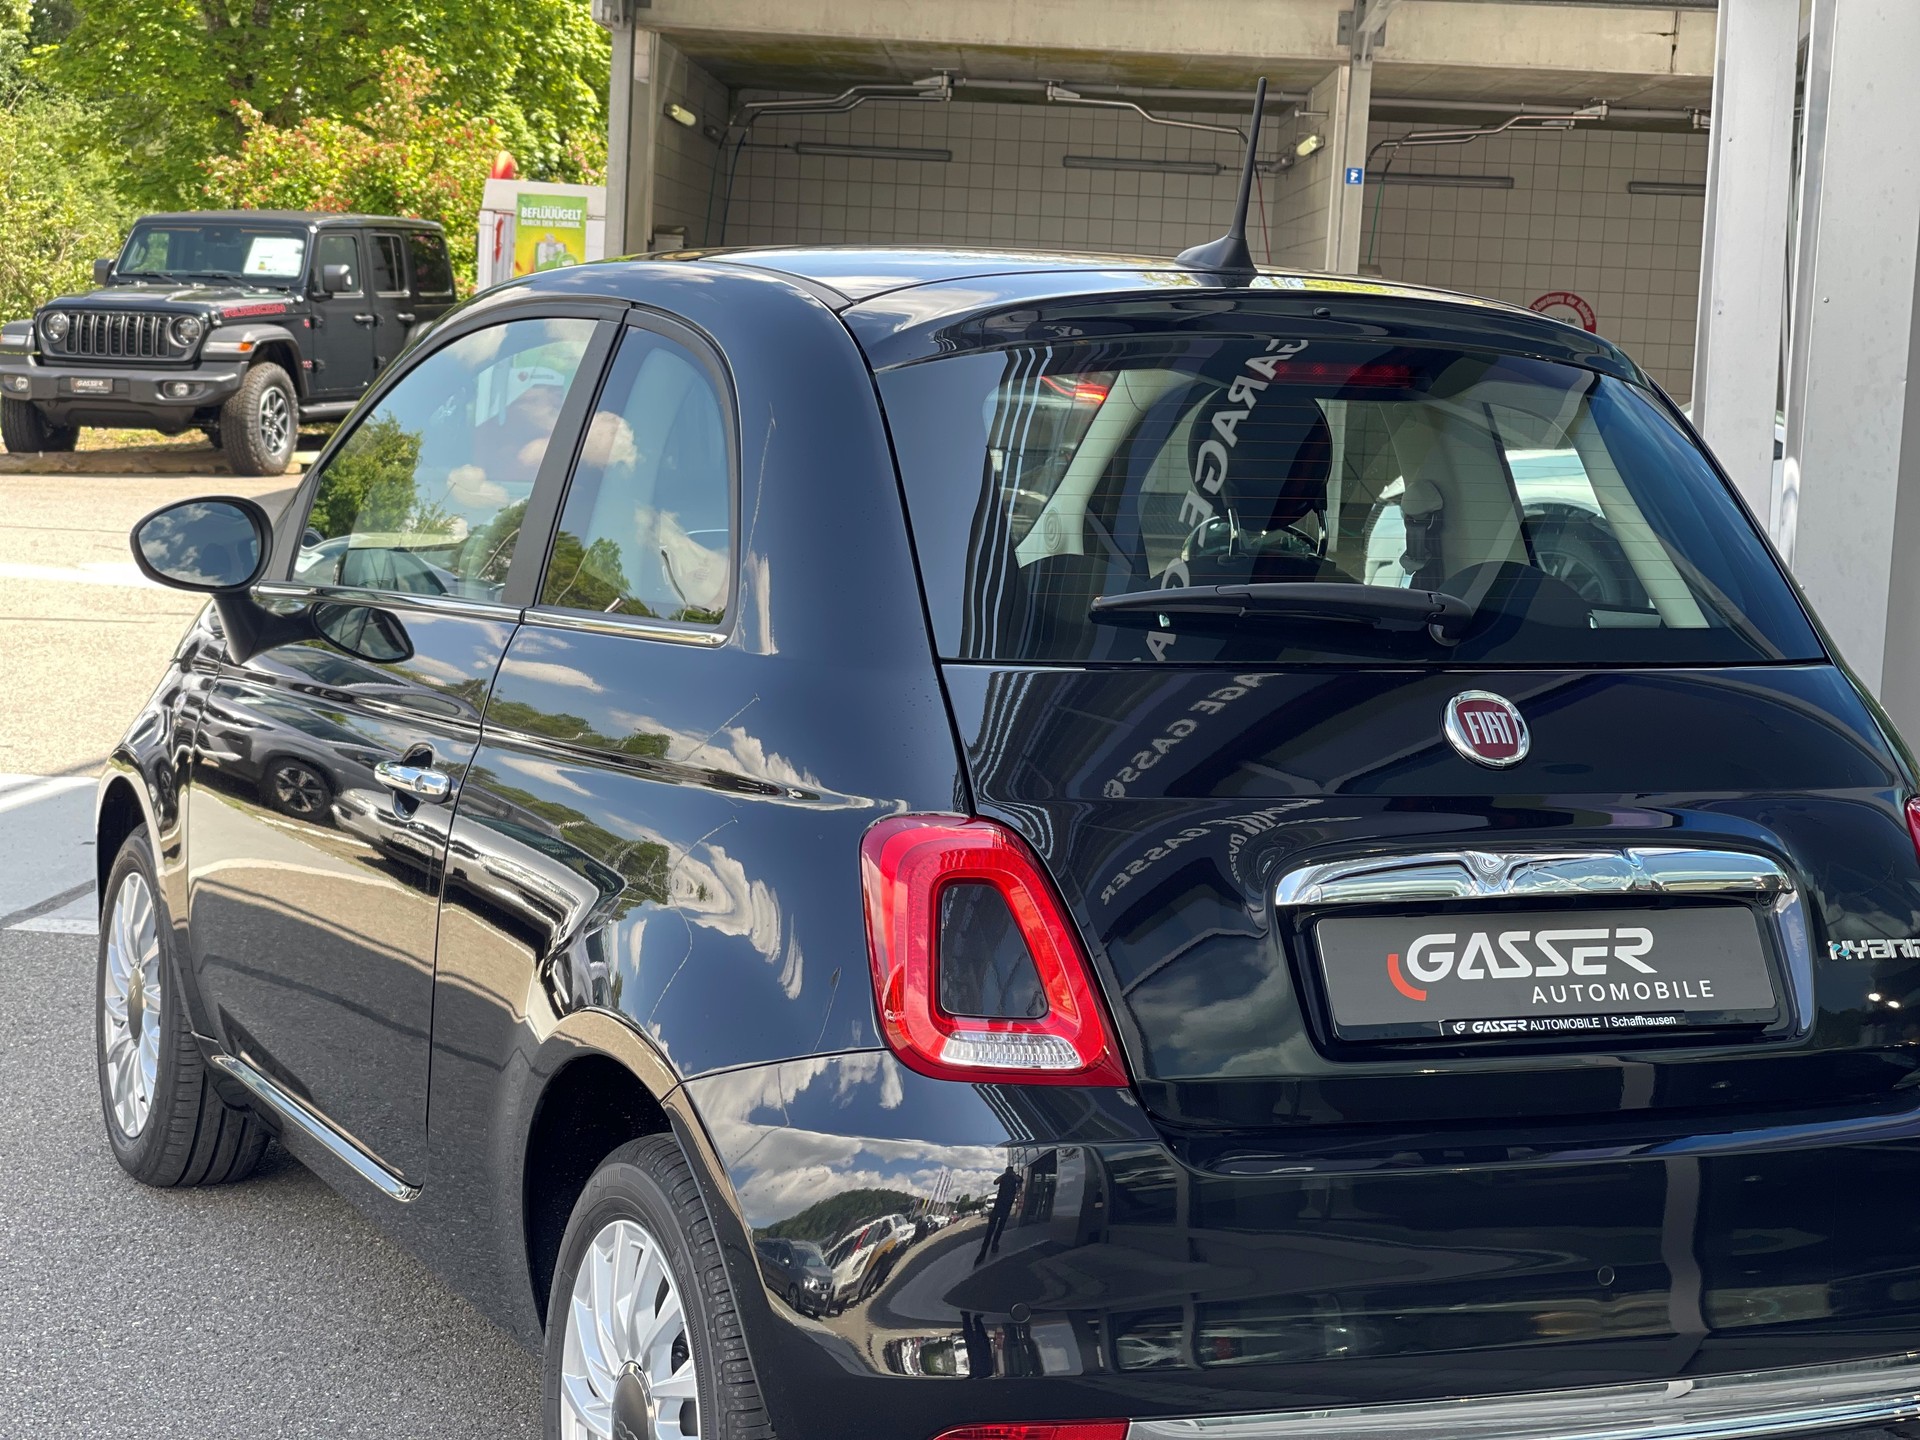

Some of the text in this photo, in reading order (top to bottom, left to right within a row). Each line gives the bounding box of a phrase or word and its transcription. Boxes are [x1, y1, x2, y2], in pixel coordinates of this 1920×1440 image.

[520, 205, 582, 220] BEFLÜÜÜGELT
[222, 304, 286, 317] RUBICON
[1463, 711, 1514, 745] FIAT
[1406, 927, 1658, 983] GASSER
[1532, 979, 1714, 1004] AUTOMOBILE
[1472, 1019, 1527, 1034] GASSER
[1530, 1017, 1601, 1031] AUTOMOBILE
[1611, 1015, 1677, 1027] Schaffhausen
